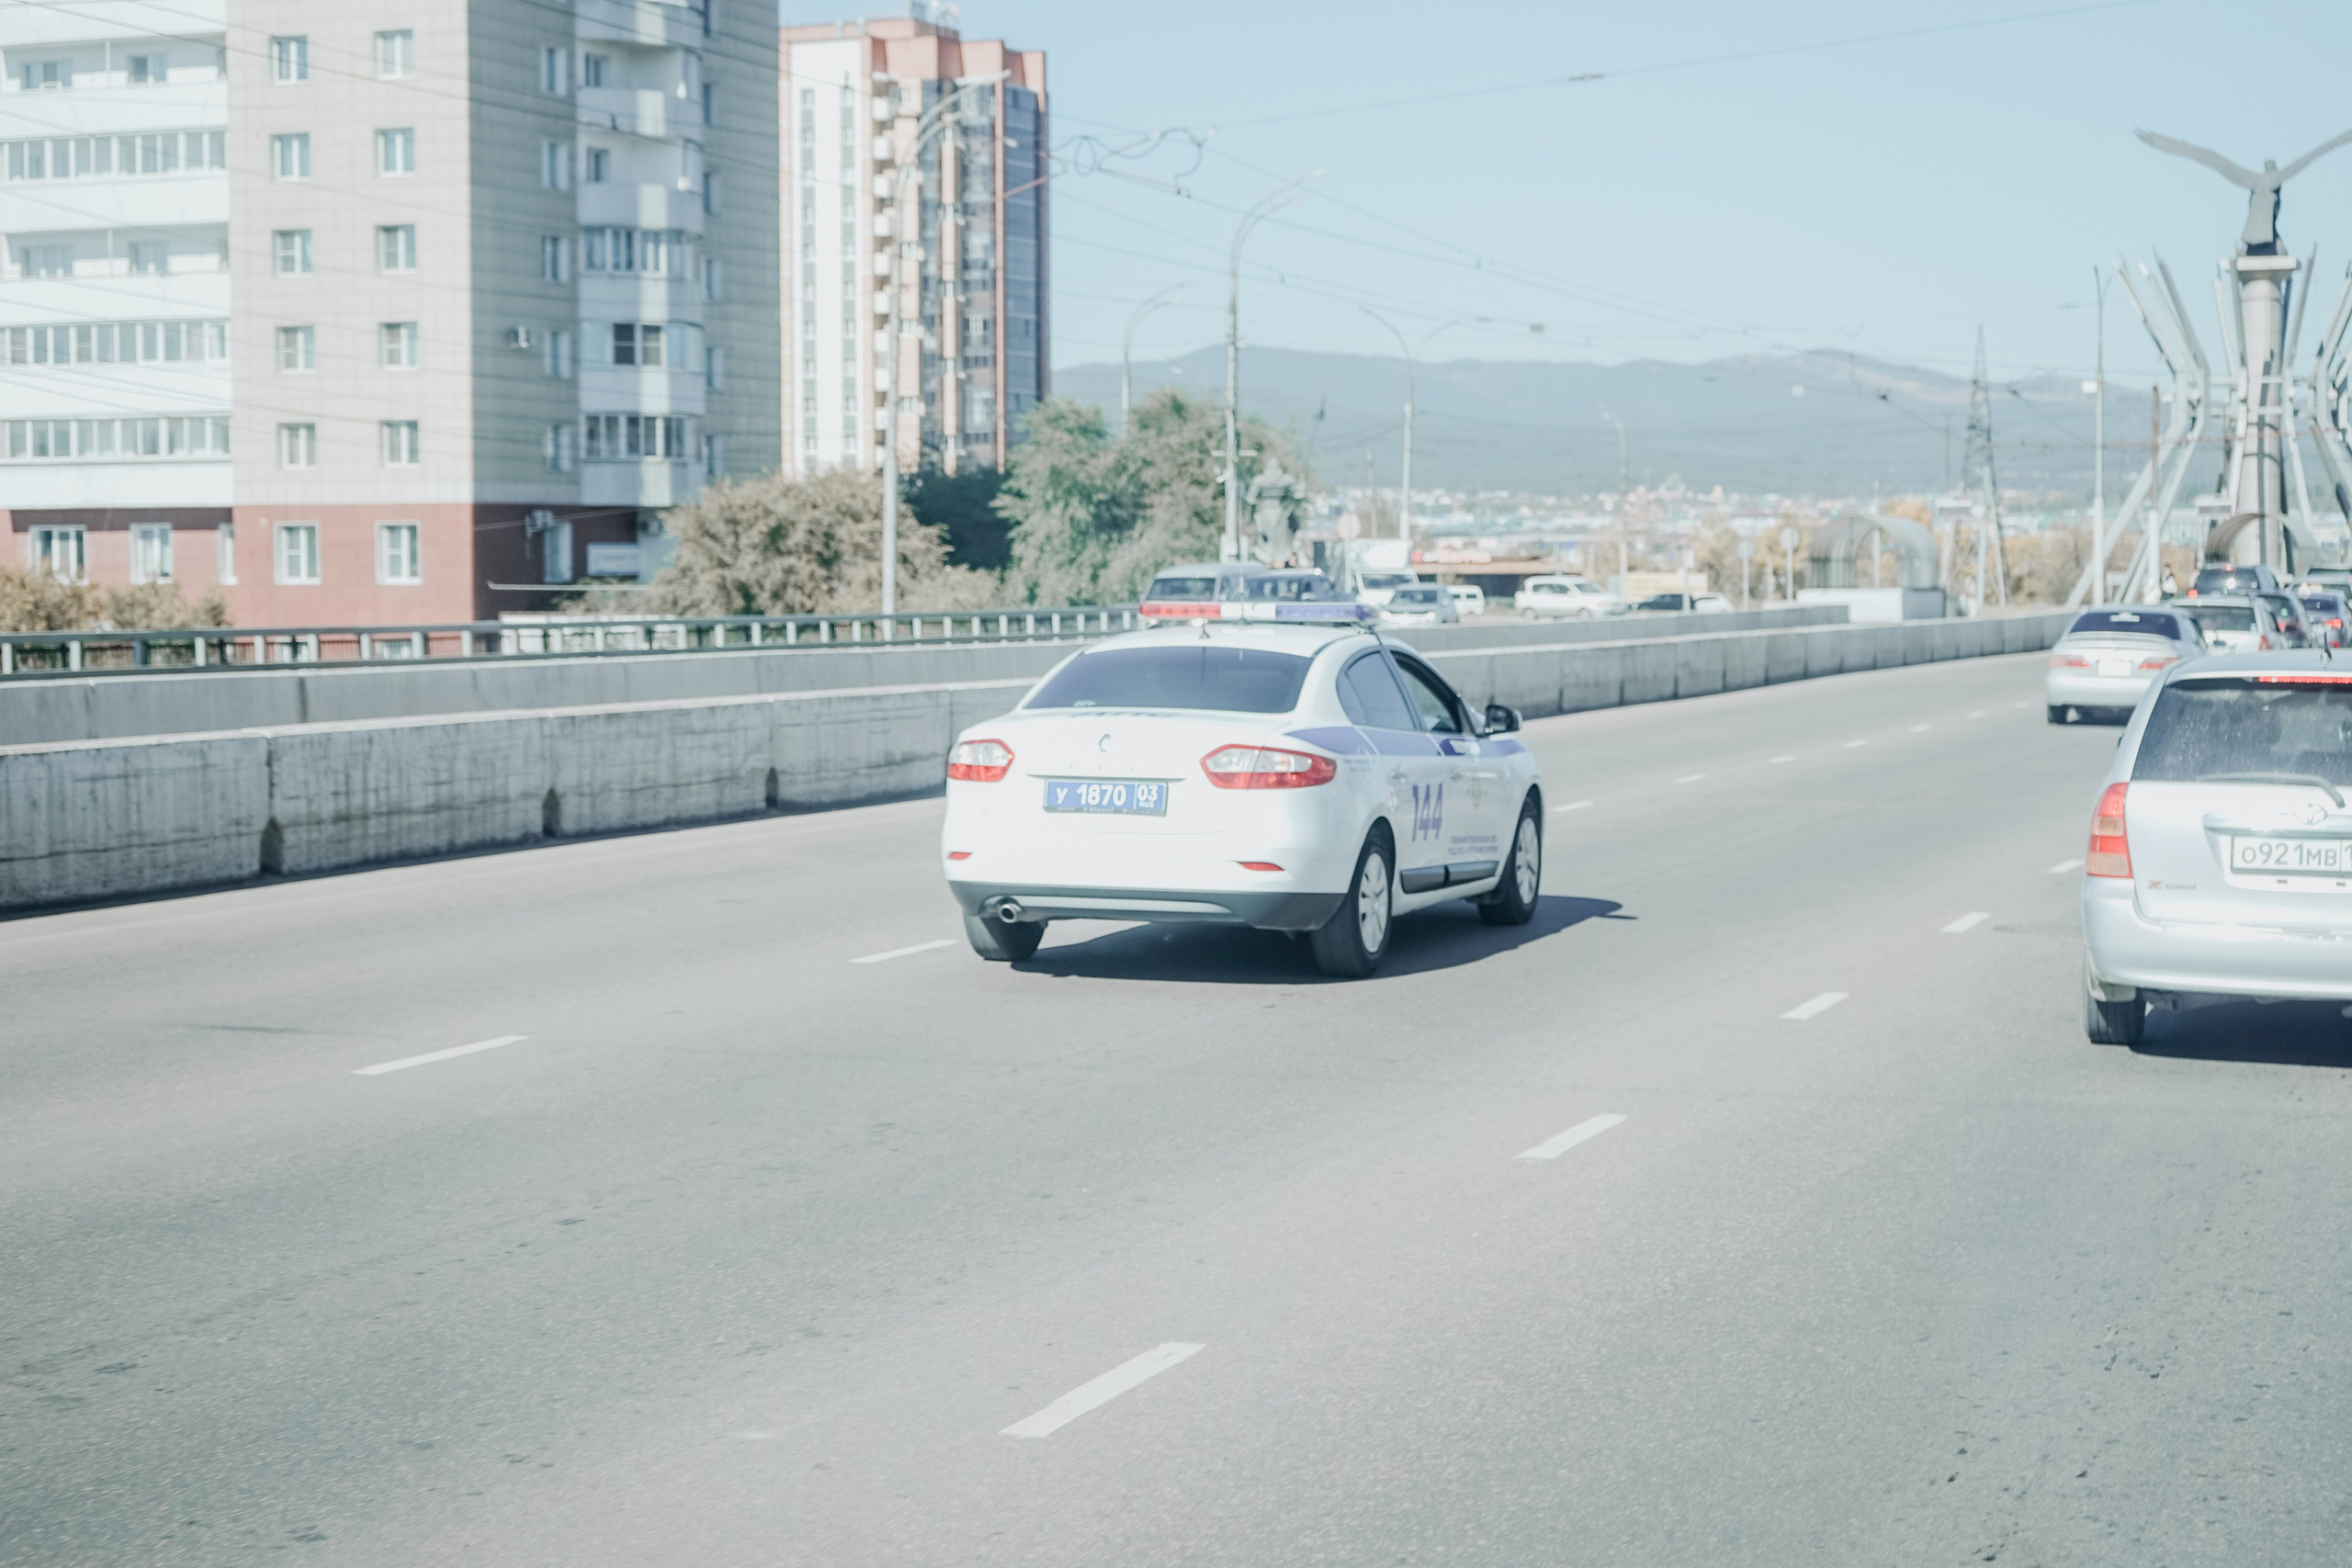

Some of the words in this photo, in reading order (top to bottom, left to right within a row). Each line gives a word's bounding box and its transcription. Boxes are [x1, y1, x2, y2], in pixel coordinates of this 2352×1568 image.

[1076, 784, 1126, 807] 1870
[1137, 784, 1158, 802] 03
[1411, 783, 1442, 842] 144
